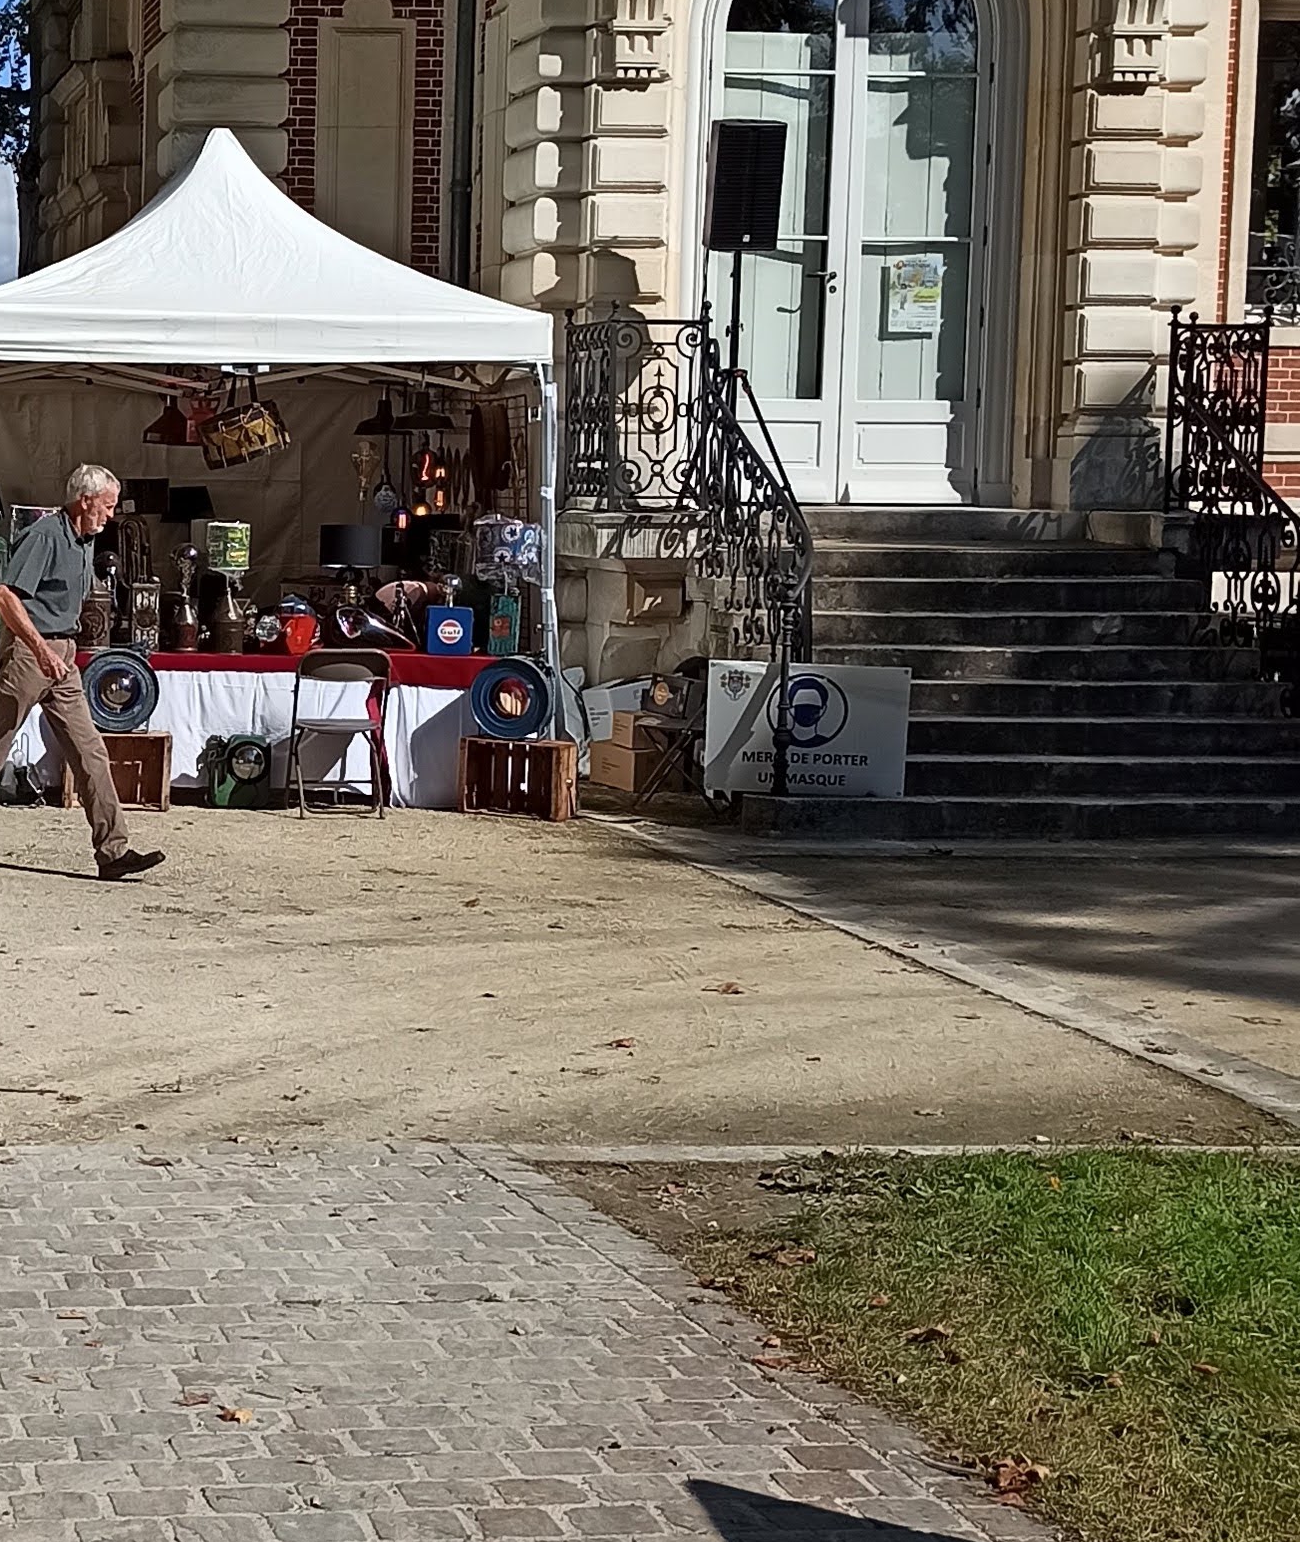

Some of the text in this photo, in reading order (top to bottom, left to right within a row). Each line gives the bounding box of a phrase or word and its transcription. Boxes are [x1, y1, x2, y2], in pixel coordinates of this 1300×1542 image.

[790, 752, 810, 765] DE
[812, 753, 868, 766] PORTER
[784, 773, 846, 787] MASQUE
